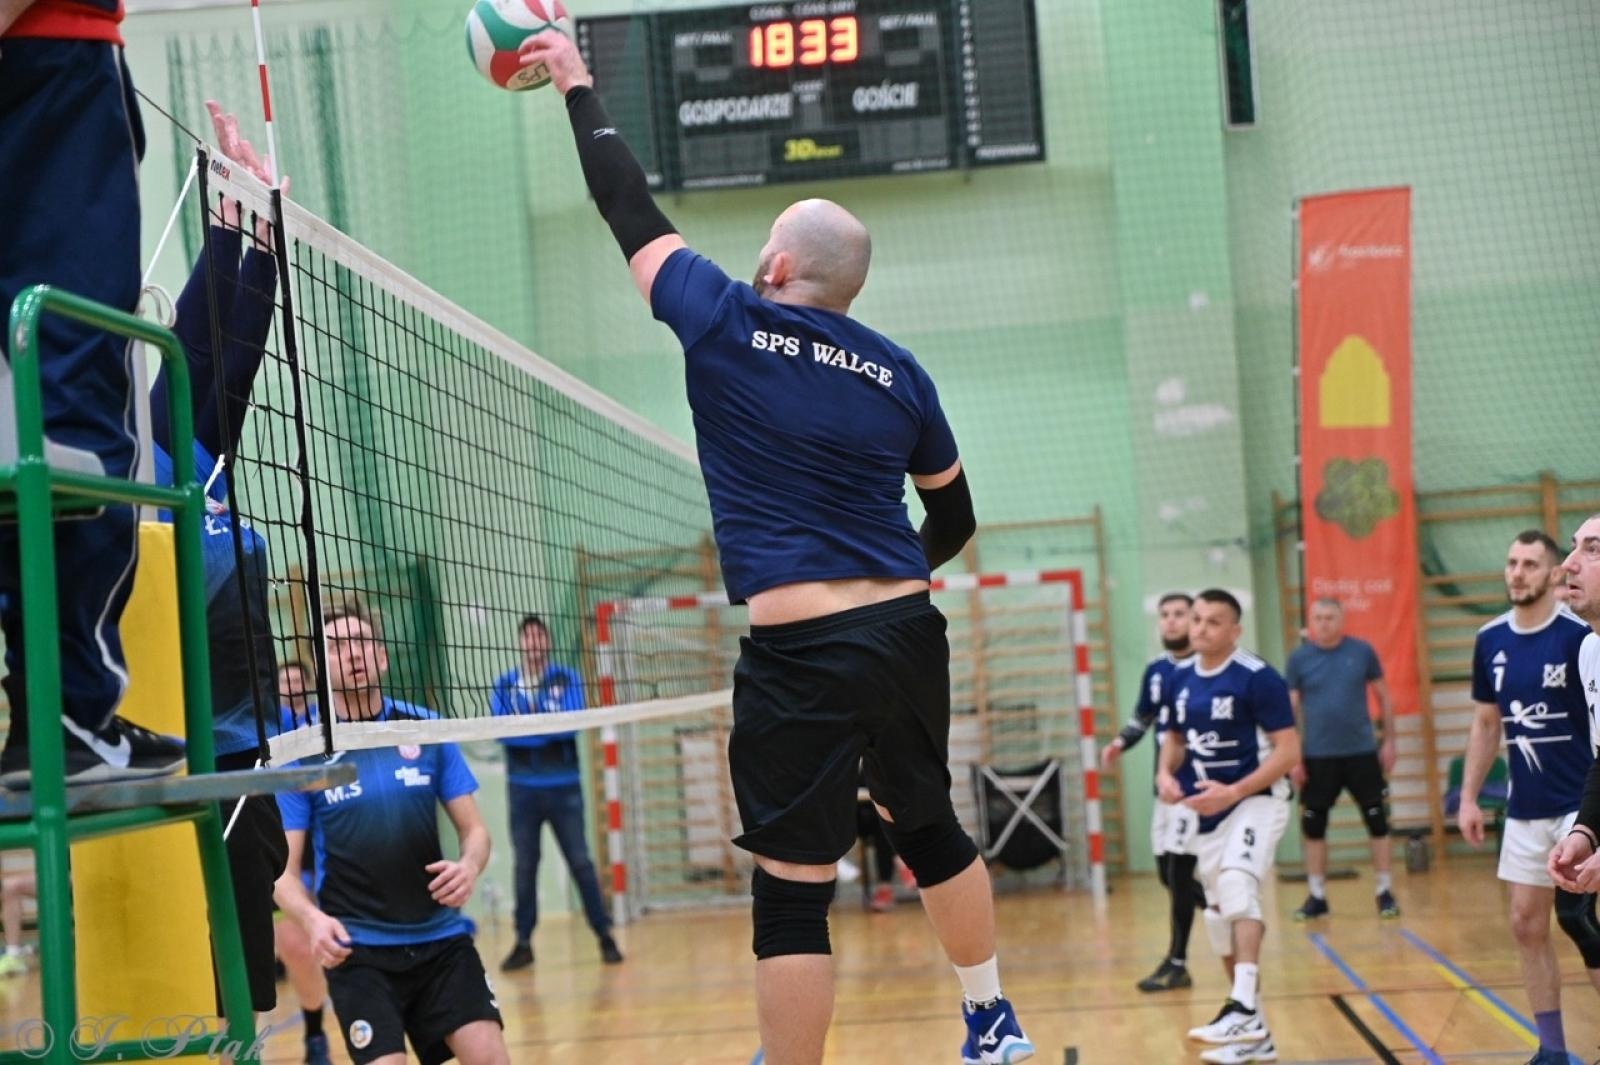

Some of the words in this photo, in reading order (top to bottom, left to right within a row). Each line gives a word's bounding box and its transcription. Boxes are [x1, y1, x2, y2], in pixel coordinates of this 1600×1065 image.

[679, 92, 794, 126] GOSPODARZE
[752, 330, 800, 356] SPS
[812, 341, 893, 388] WALCE
[1243, 827, 1256, 847] 5
